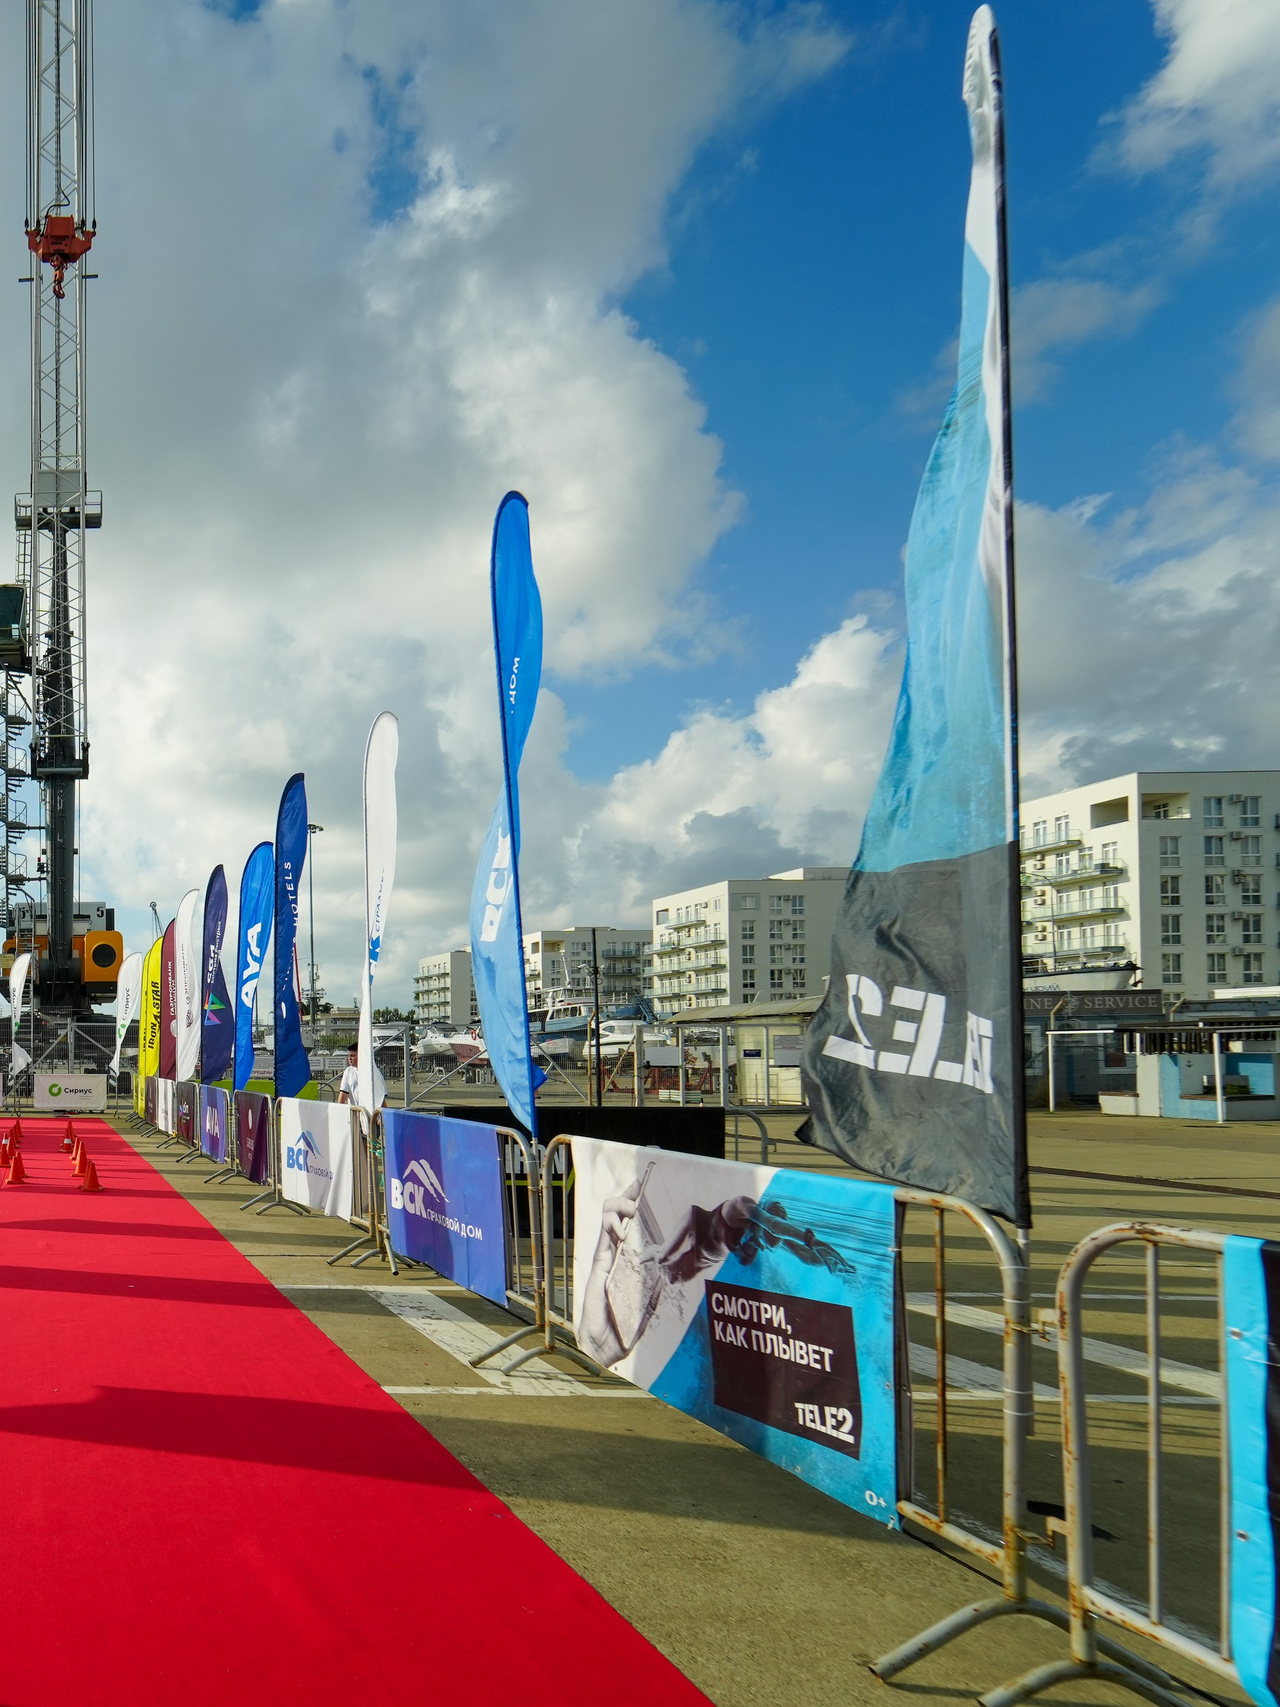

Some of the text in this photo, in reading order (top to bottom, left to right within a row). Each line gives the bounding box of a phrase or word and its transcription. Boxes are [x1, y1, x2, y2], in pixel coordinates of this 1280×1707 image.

[97, 906, 104, 918] 5
[241, 922, 262, 1009] AVA
[147, 980, 160, 1050] IRON STAR
[1084, 996, 1158, 1009] SERVICE
[64, 1087, 93, 1095] Сириус
[206, 1105, 220, 1139] AVA
[286, 1146, 310, 1173] ВСК
[391, 1177, 483, 1241] ВСК СТРАХОВОЙ ДОМ
[711, 1292, 793, 1335] СМОТРИ,
[713, 1319, 834, 1373] КАК ПЛЫВЕТ
[794, 1402, 855, 1445] TELE2
[865, 1490, 887, 1508] 0+
